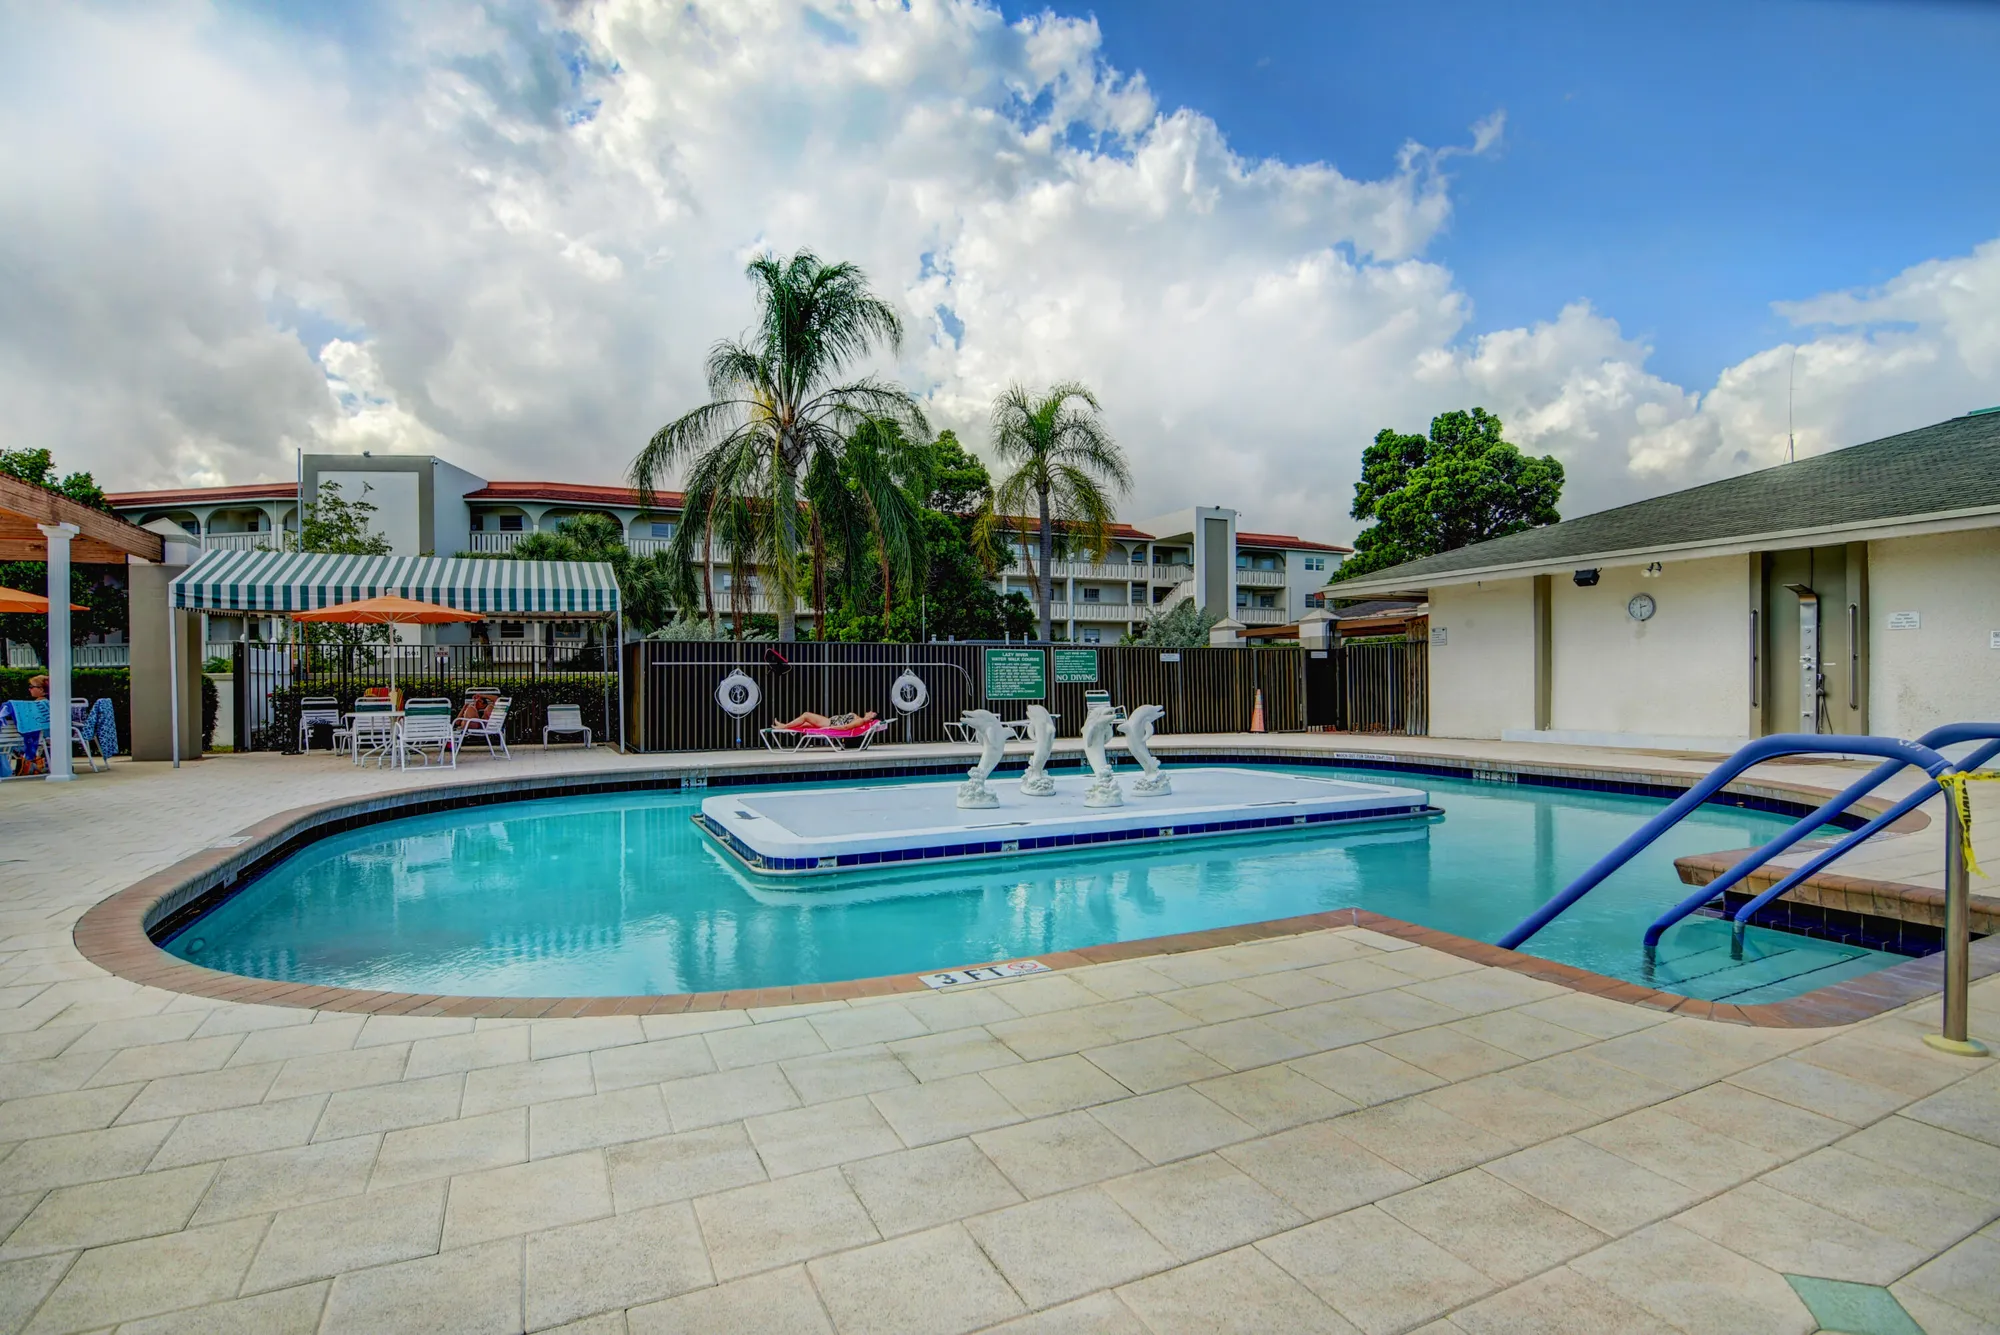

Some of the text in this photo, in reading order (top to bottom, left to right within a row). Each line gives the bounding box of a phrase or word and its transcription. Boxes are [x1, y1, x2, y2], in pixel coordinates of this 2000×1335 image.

[685, 778, 691, 787] 3
[1475, 770, 1515, 783] 3 FT 3 IN
[934, 973, 958, 985] 3
[963, 966, 1004, 981] FT
